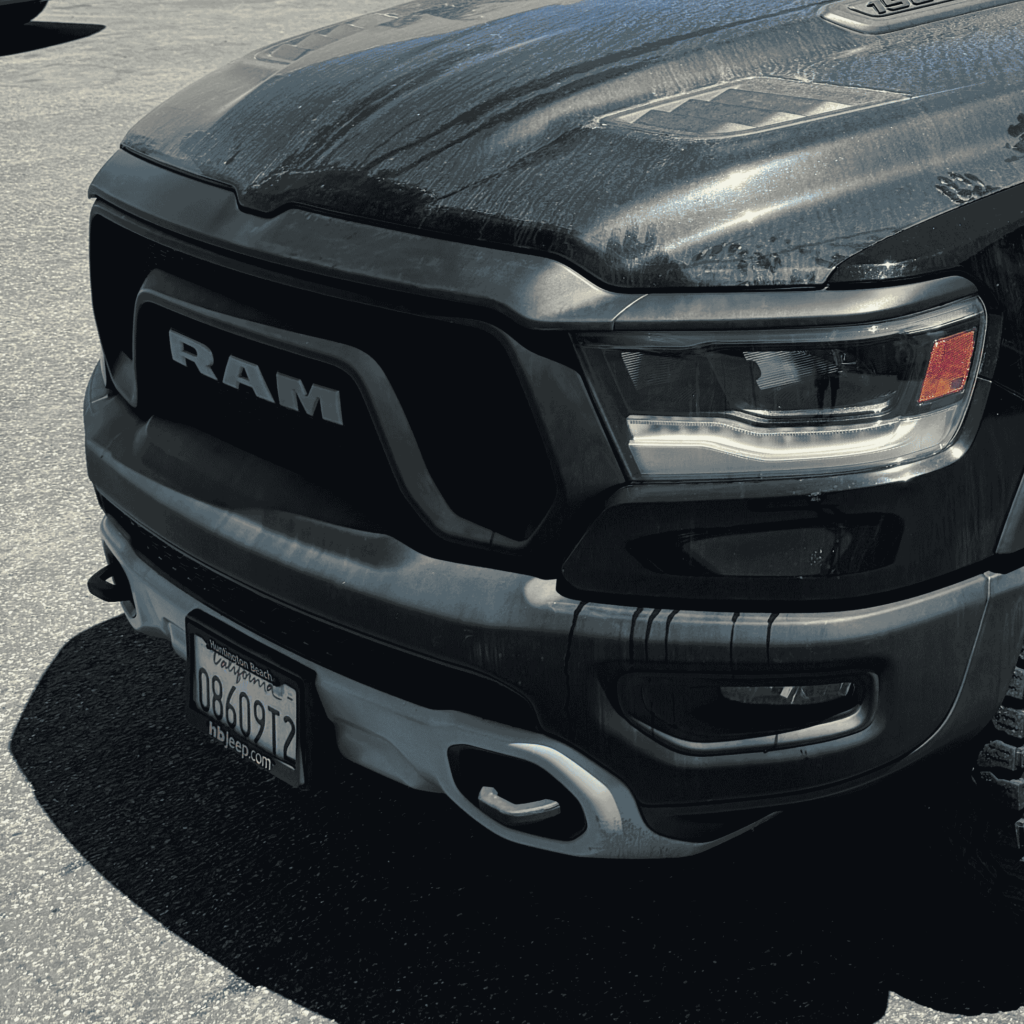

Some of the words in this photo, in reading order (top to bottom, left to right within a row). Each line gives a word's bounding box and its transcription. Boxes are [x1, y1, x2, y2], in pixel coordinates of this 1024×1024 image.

[168, 327, 343, 426] RAM
[209, 639, 249, 670] Huntington
[250, 660, 274, 681] Beach
[199, 667, 296, 763] 08609T2
[208, 721, 272, 771] hbjeep.com
